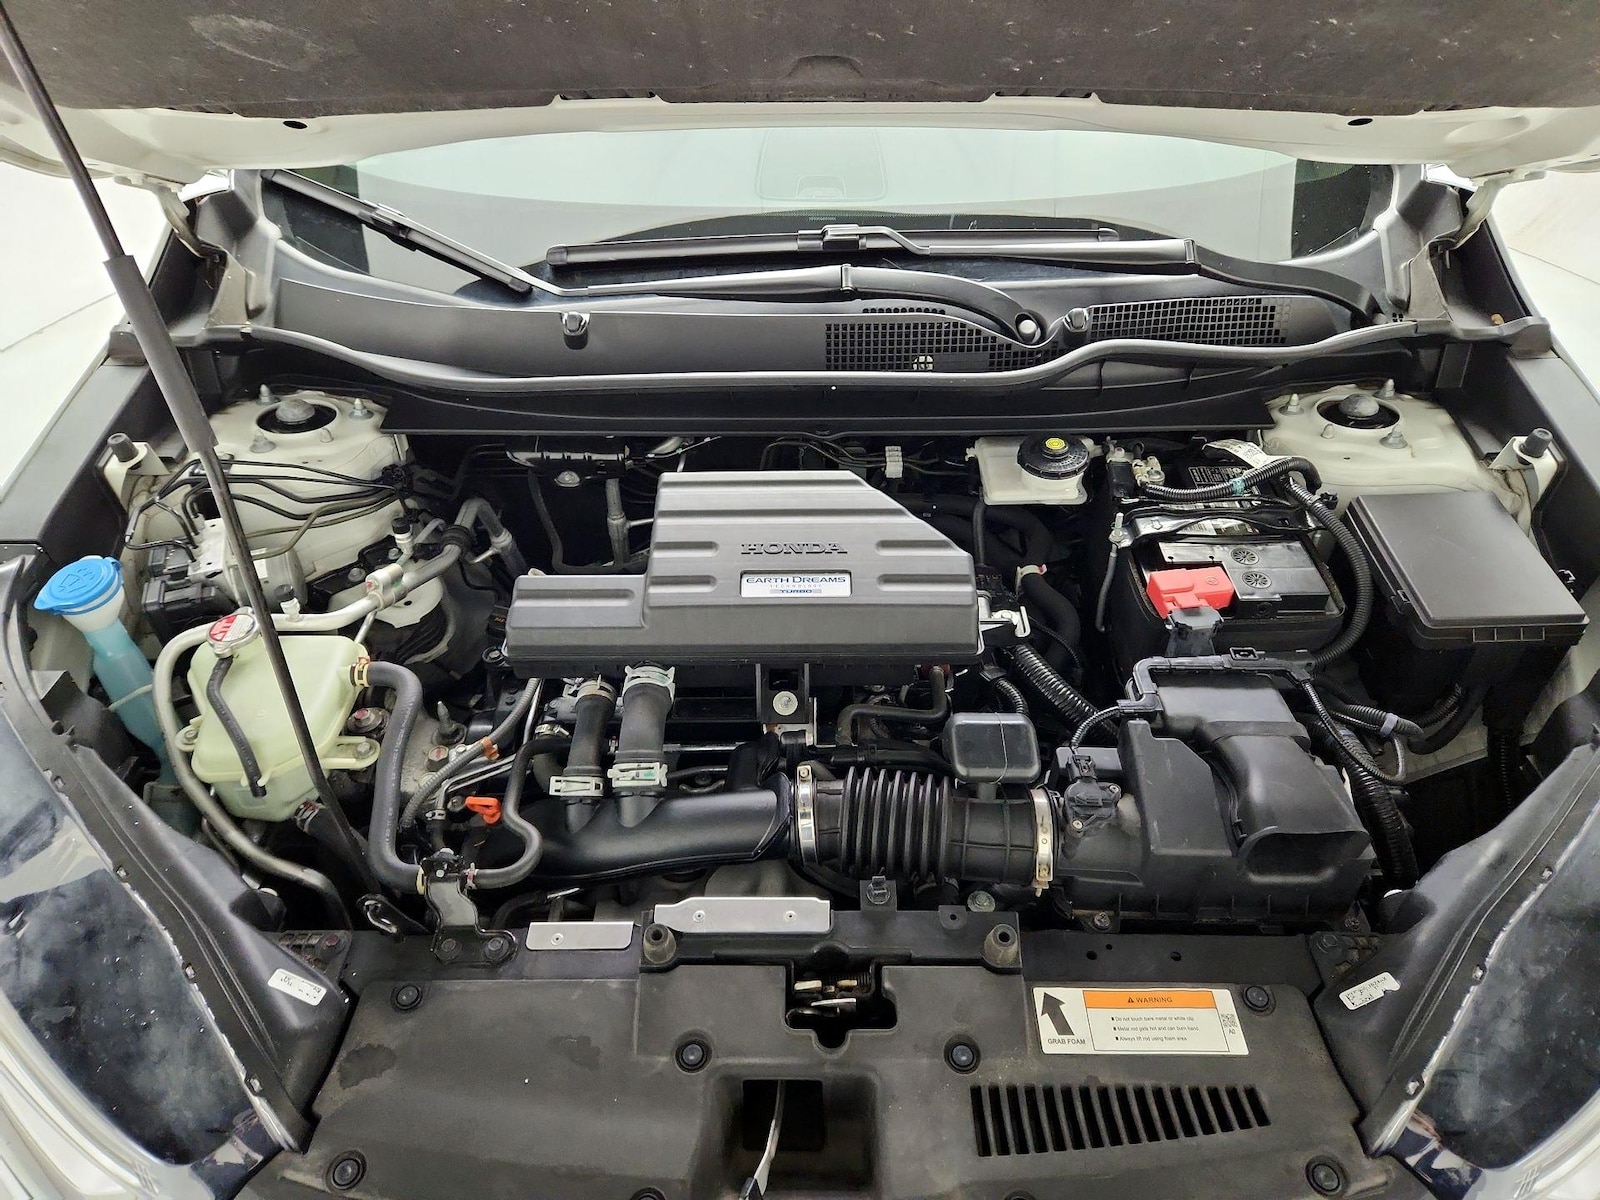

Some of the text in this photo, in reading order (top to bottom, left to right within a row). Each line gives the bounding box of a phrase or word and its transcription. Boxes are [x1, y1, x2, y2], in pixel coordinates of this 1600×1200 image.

[741, 541, 848, 555] HONDA
[746, 575, 846, 584] EARTH DREAMS
